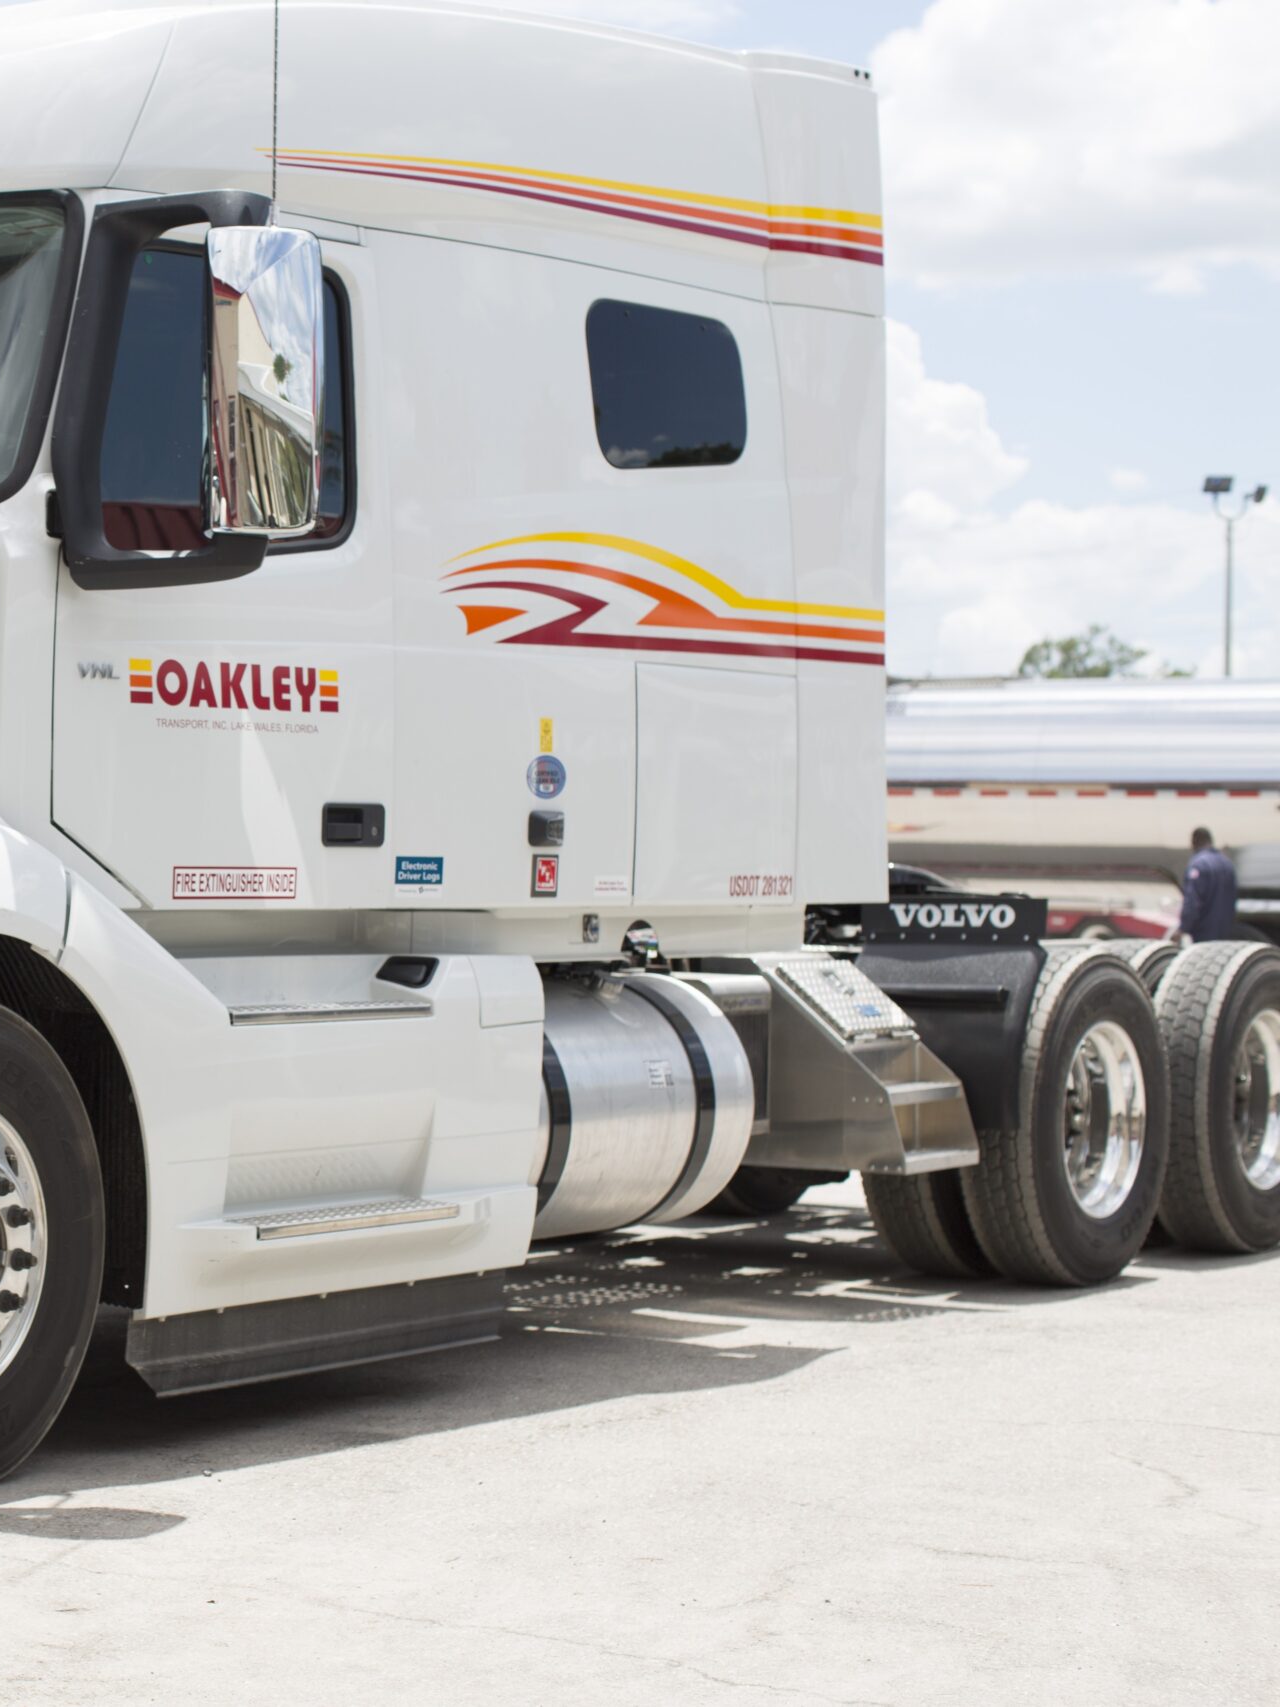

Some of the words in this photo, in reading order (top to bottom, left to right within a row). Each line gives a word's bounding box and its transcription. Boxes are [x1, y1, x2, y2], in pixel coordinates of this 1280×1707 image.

[77, 662, 121, 680] VNL
[156, 659, 316, 713] OAKLEY
[231, 720, 252, 731] LAKE
[285, 723, 319, 734] FLORIDA
[176, 873, 196, 892] FIRE
[199, 873, 264, 892] EXTINGUISHER
[266, 873, 294, 892] INSIDE
[398, 870, 421, 880] Driver
[423, 871, 440, 883] Logs
[729, 875, 760, 897] USDOT
[889, 903, 1016, 929] VOLVO
